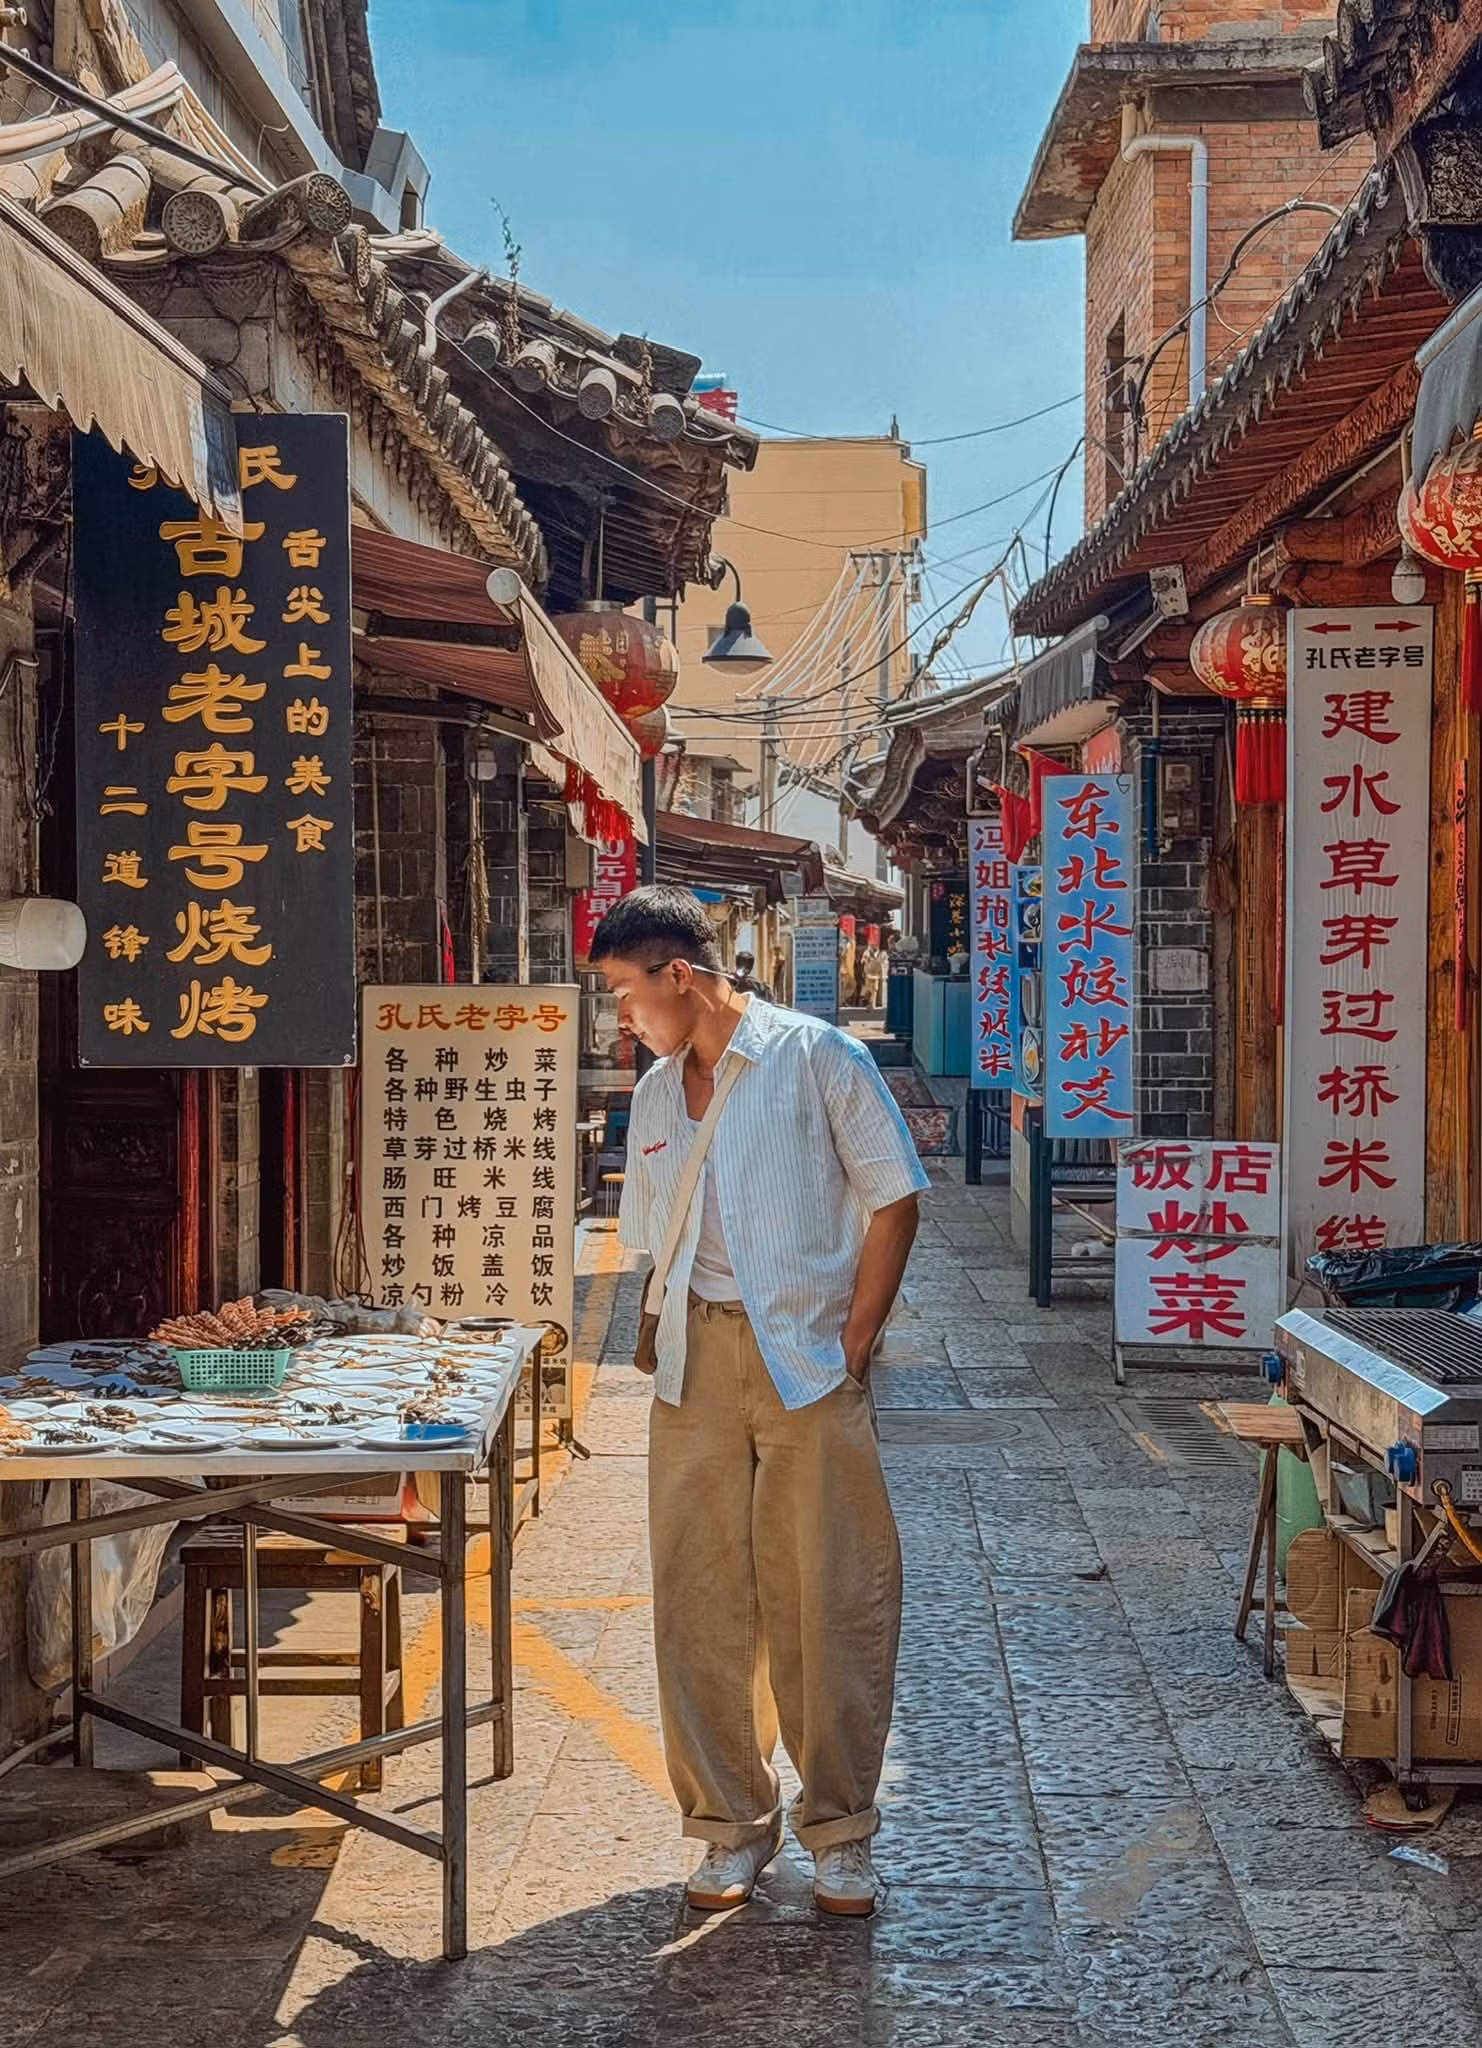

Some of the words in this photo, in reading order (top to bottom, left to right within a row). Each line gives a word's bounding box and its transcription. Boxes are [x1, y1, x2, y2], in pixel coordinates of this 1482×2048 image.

[1305, 645, 1425, 670] 孔氏老字号
[282, 528, 335, 853] 舌尖上的美食
[159, 507, 273, 1043] 古城老字号烧烤
[97, 713, 152, 1037] 十二道锋味
[1317, 689, 1402, 1250] 建水草芽过桥米线
[375, 1002, 569, 1033] 孔氏老字号
[384, 1047, 558, 1073] 各种炒菜
[383, 1076, 557, 1102] 各种野生虫子
[383, 1106, 557, 1132] 特色烧烤
[382, 1136, 556, 1161] 草芽过桥米线
[382, 1166, 556, 1190] 肠旺米线
[1130, 1144, 1273, 1195] 饭店
[382, 1195, 555, 1219] 西门烤豆腐
[381, 1223, 554, 1249] 各种凉品
[380, 1253, 554, 1278] 炒饭盖饭
